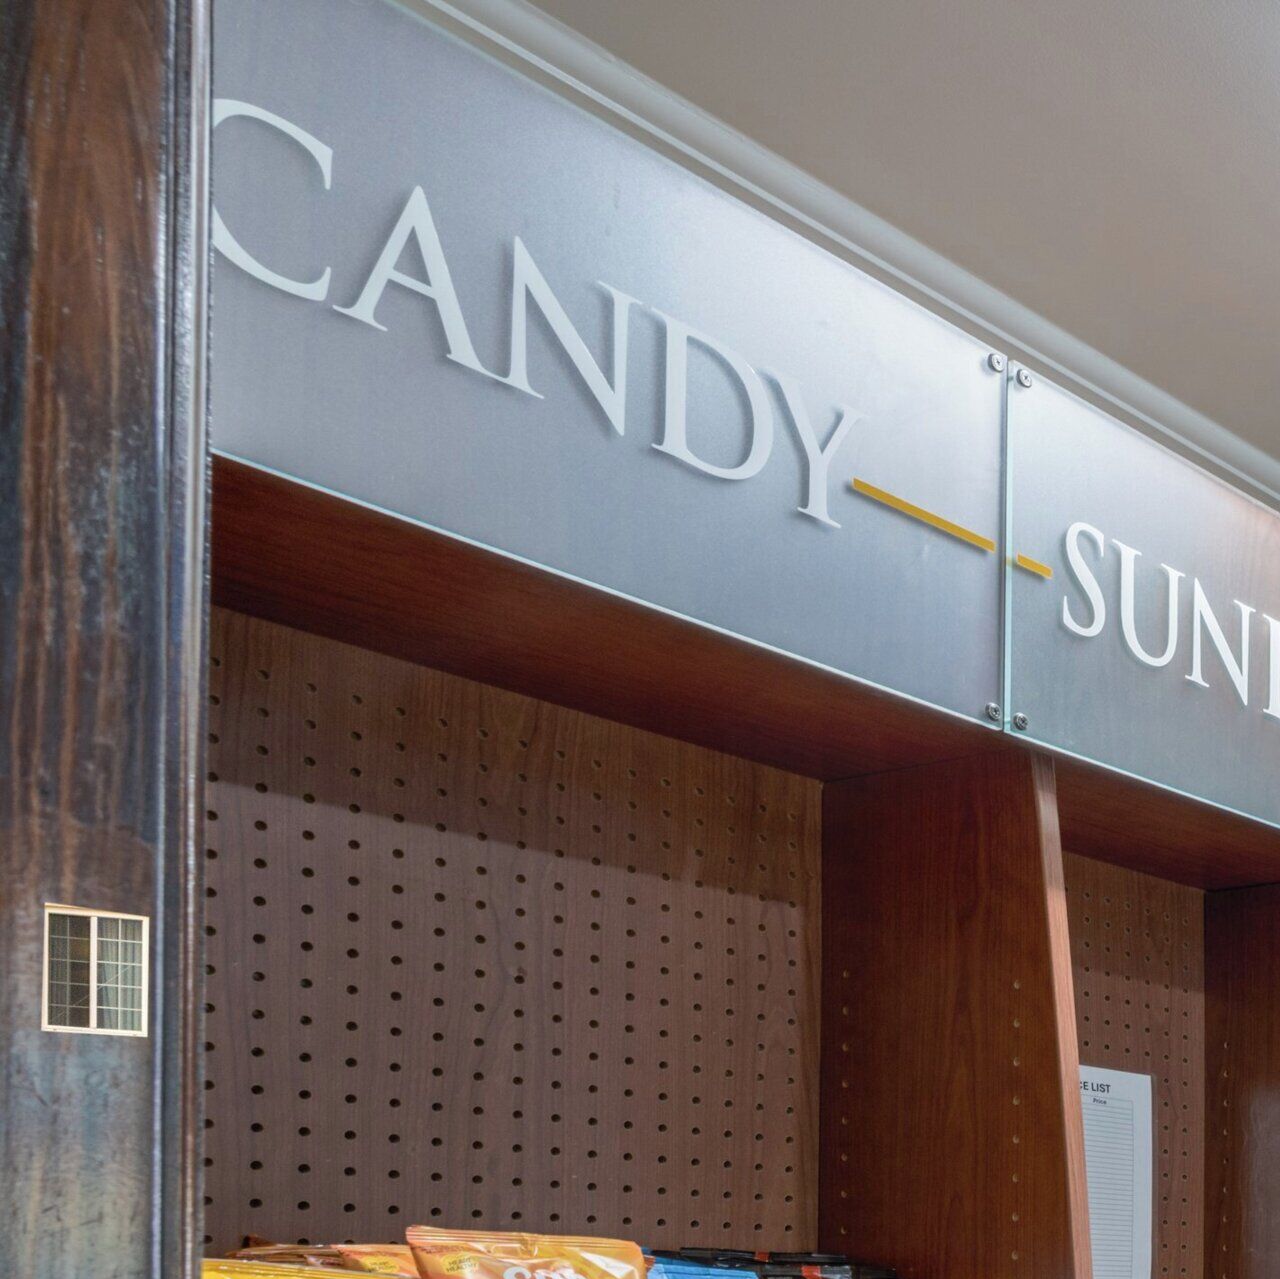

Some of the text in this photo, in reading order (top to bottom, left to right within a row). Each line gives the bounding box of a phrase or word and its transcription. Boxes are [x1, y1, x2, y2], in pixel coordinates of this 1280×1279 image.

[211, 98, 866, 528] CANDY
[1091, 1082, 1111, 1094] LIST
[1093, 1097, 1107, 1105] Price
